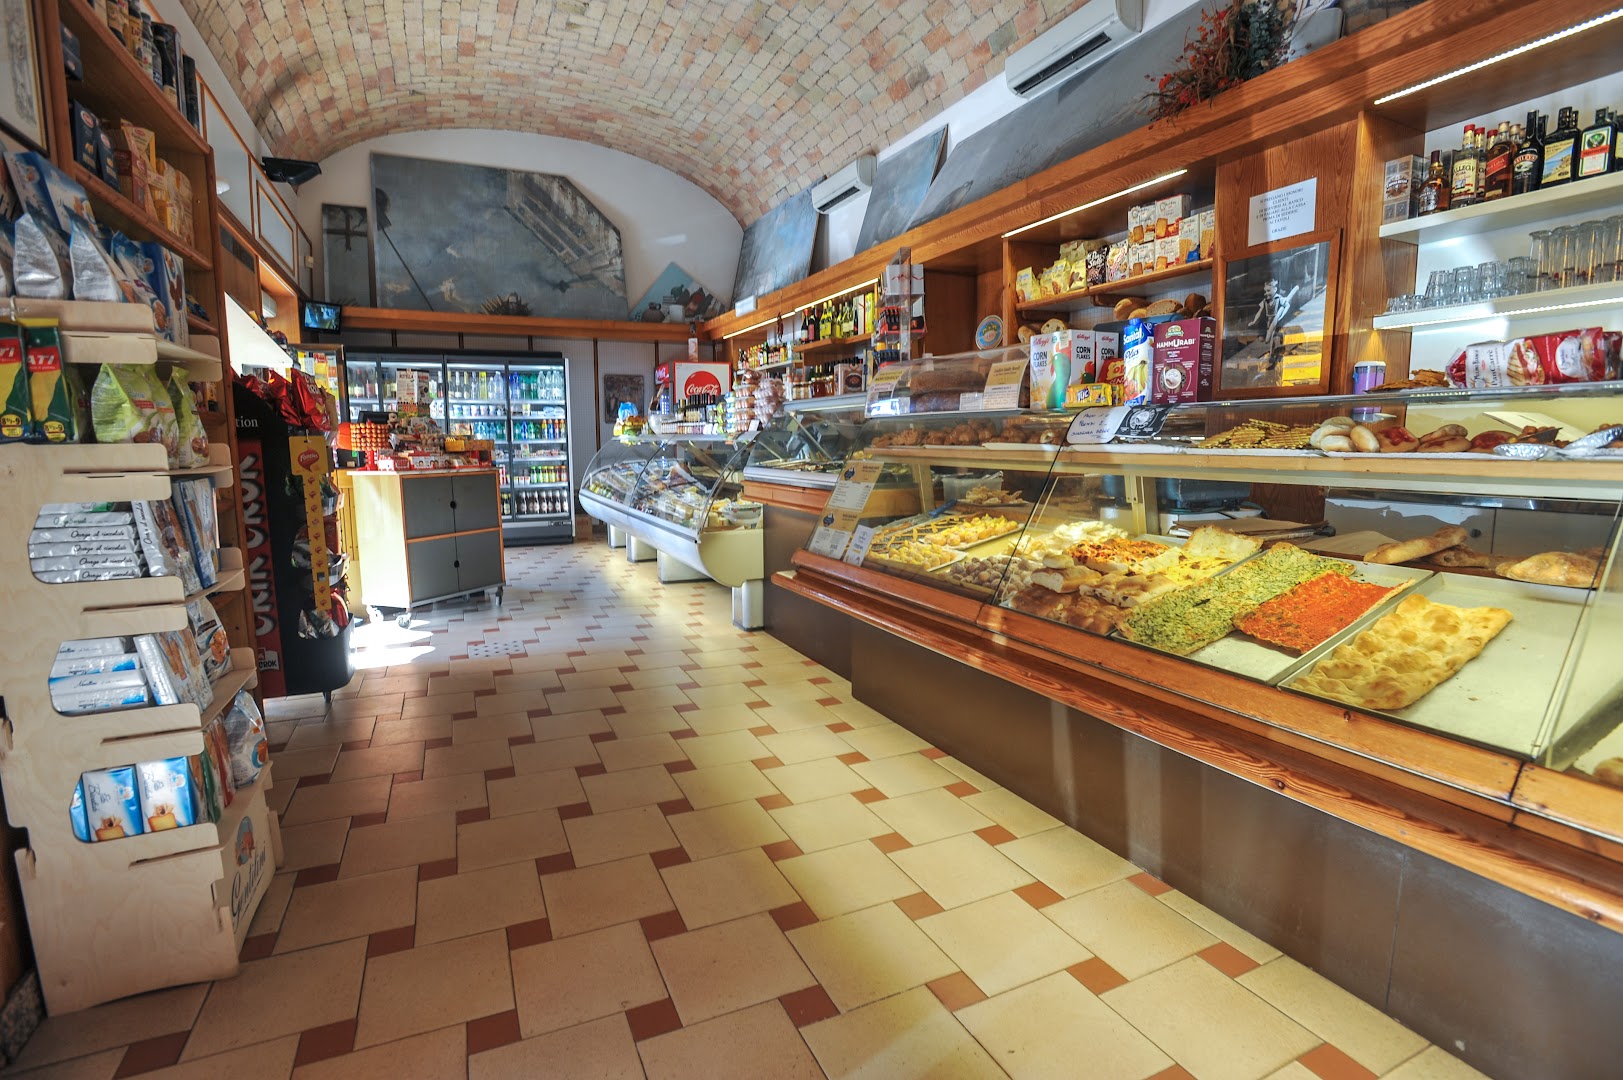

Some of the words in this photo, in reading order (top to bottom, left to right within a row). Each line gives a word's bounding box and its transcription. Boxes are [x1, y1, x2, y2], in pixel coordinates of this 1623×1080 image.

[1264, 194, 1283, 202] PREGANO
[1286, 188, 1304, 196] SIGNORI
[1033, 338, 1050, 347] Kellogg's
[1156, 338, 1195, 349] HAMMURABI
[1033, 351, 1048, 360] CORN
[1125, 349, 1139, 359] Plus
[1077, 388, 1090, 401] TUC
[299, 453, 319, 462] Fonzies
